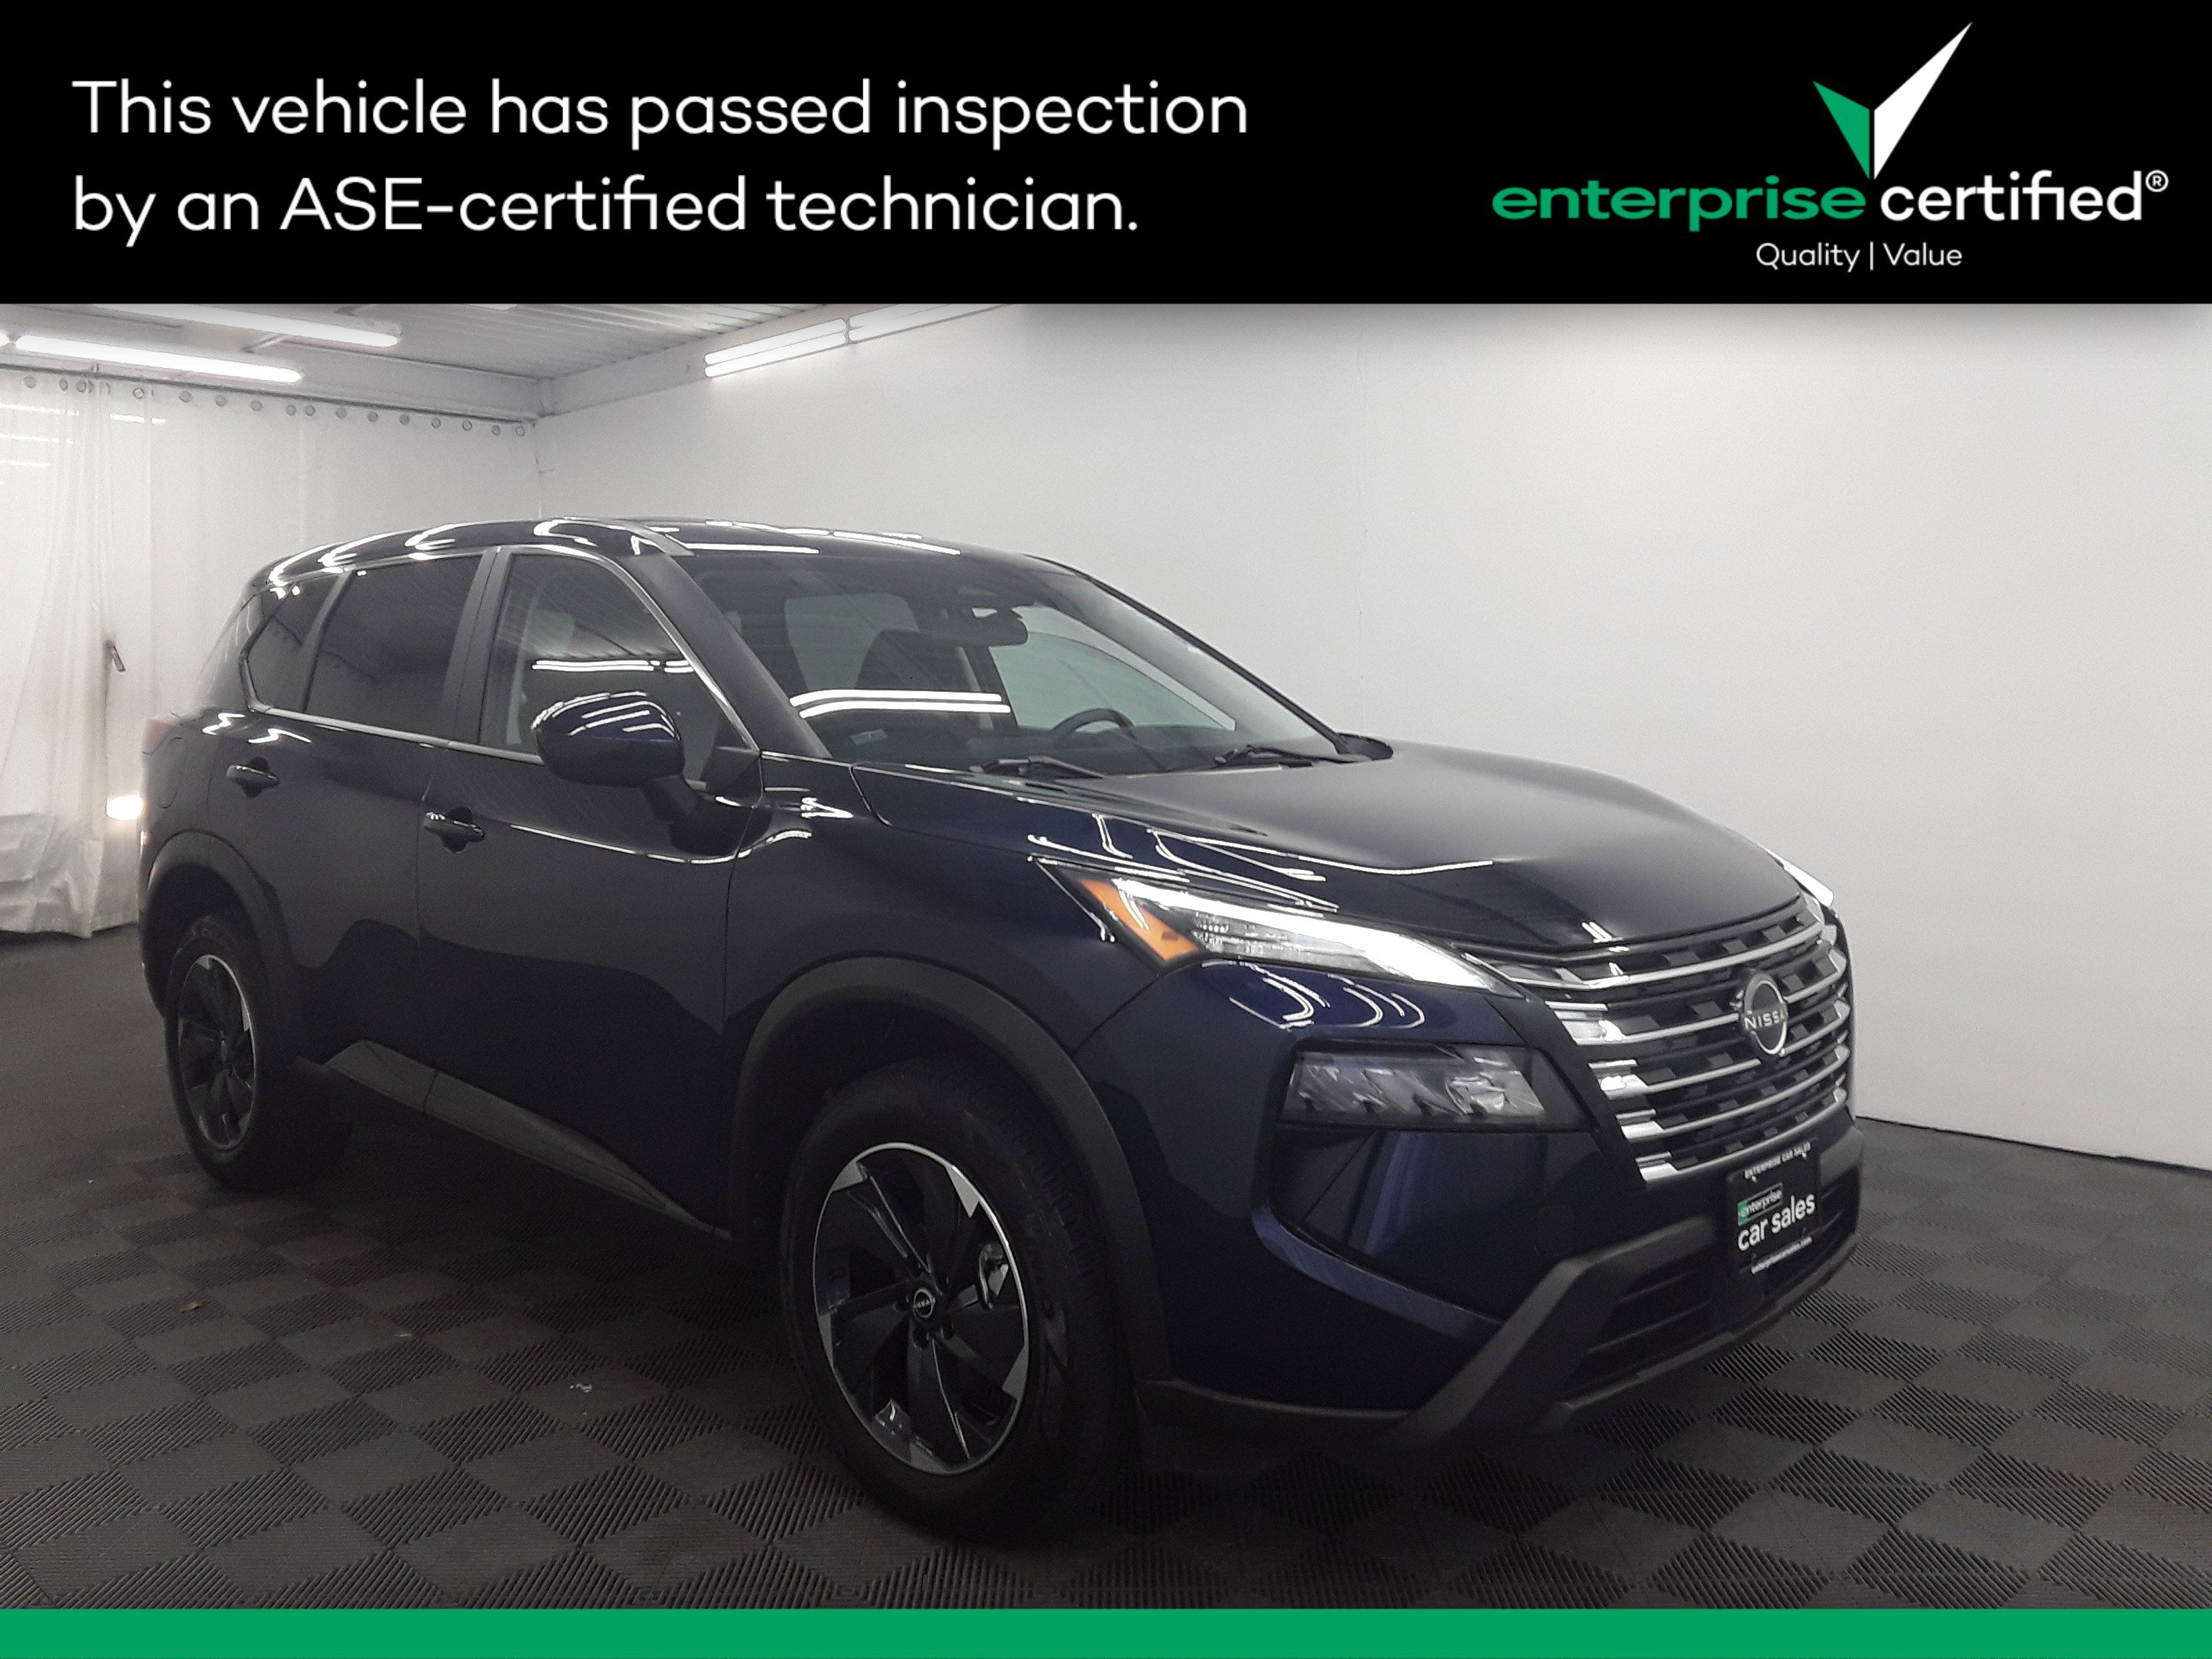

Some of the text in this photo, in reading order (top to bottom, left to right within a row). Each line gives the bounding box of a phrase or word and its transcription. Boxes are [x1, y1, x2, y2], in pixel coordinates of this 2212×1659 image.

[1744, 1008, 1784, 1030] NISS
[1738, 1193, 1816, 1251] car sales
